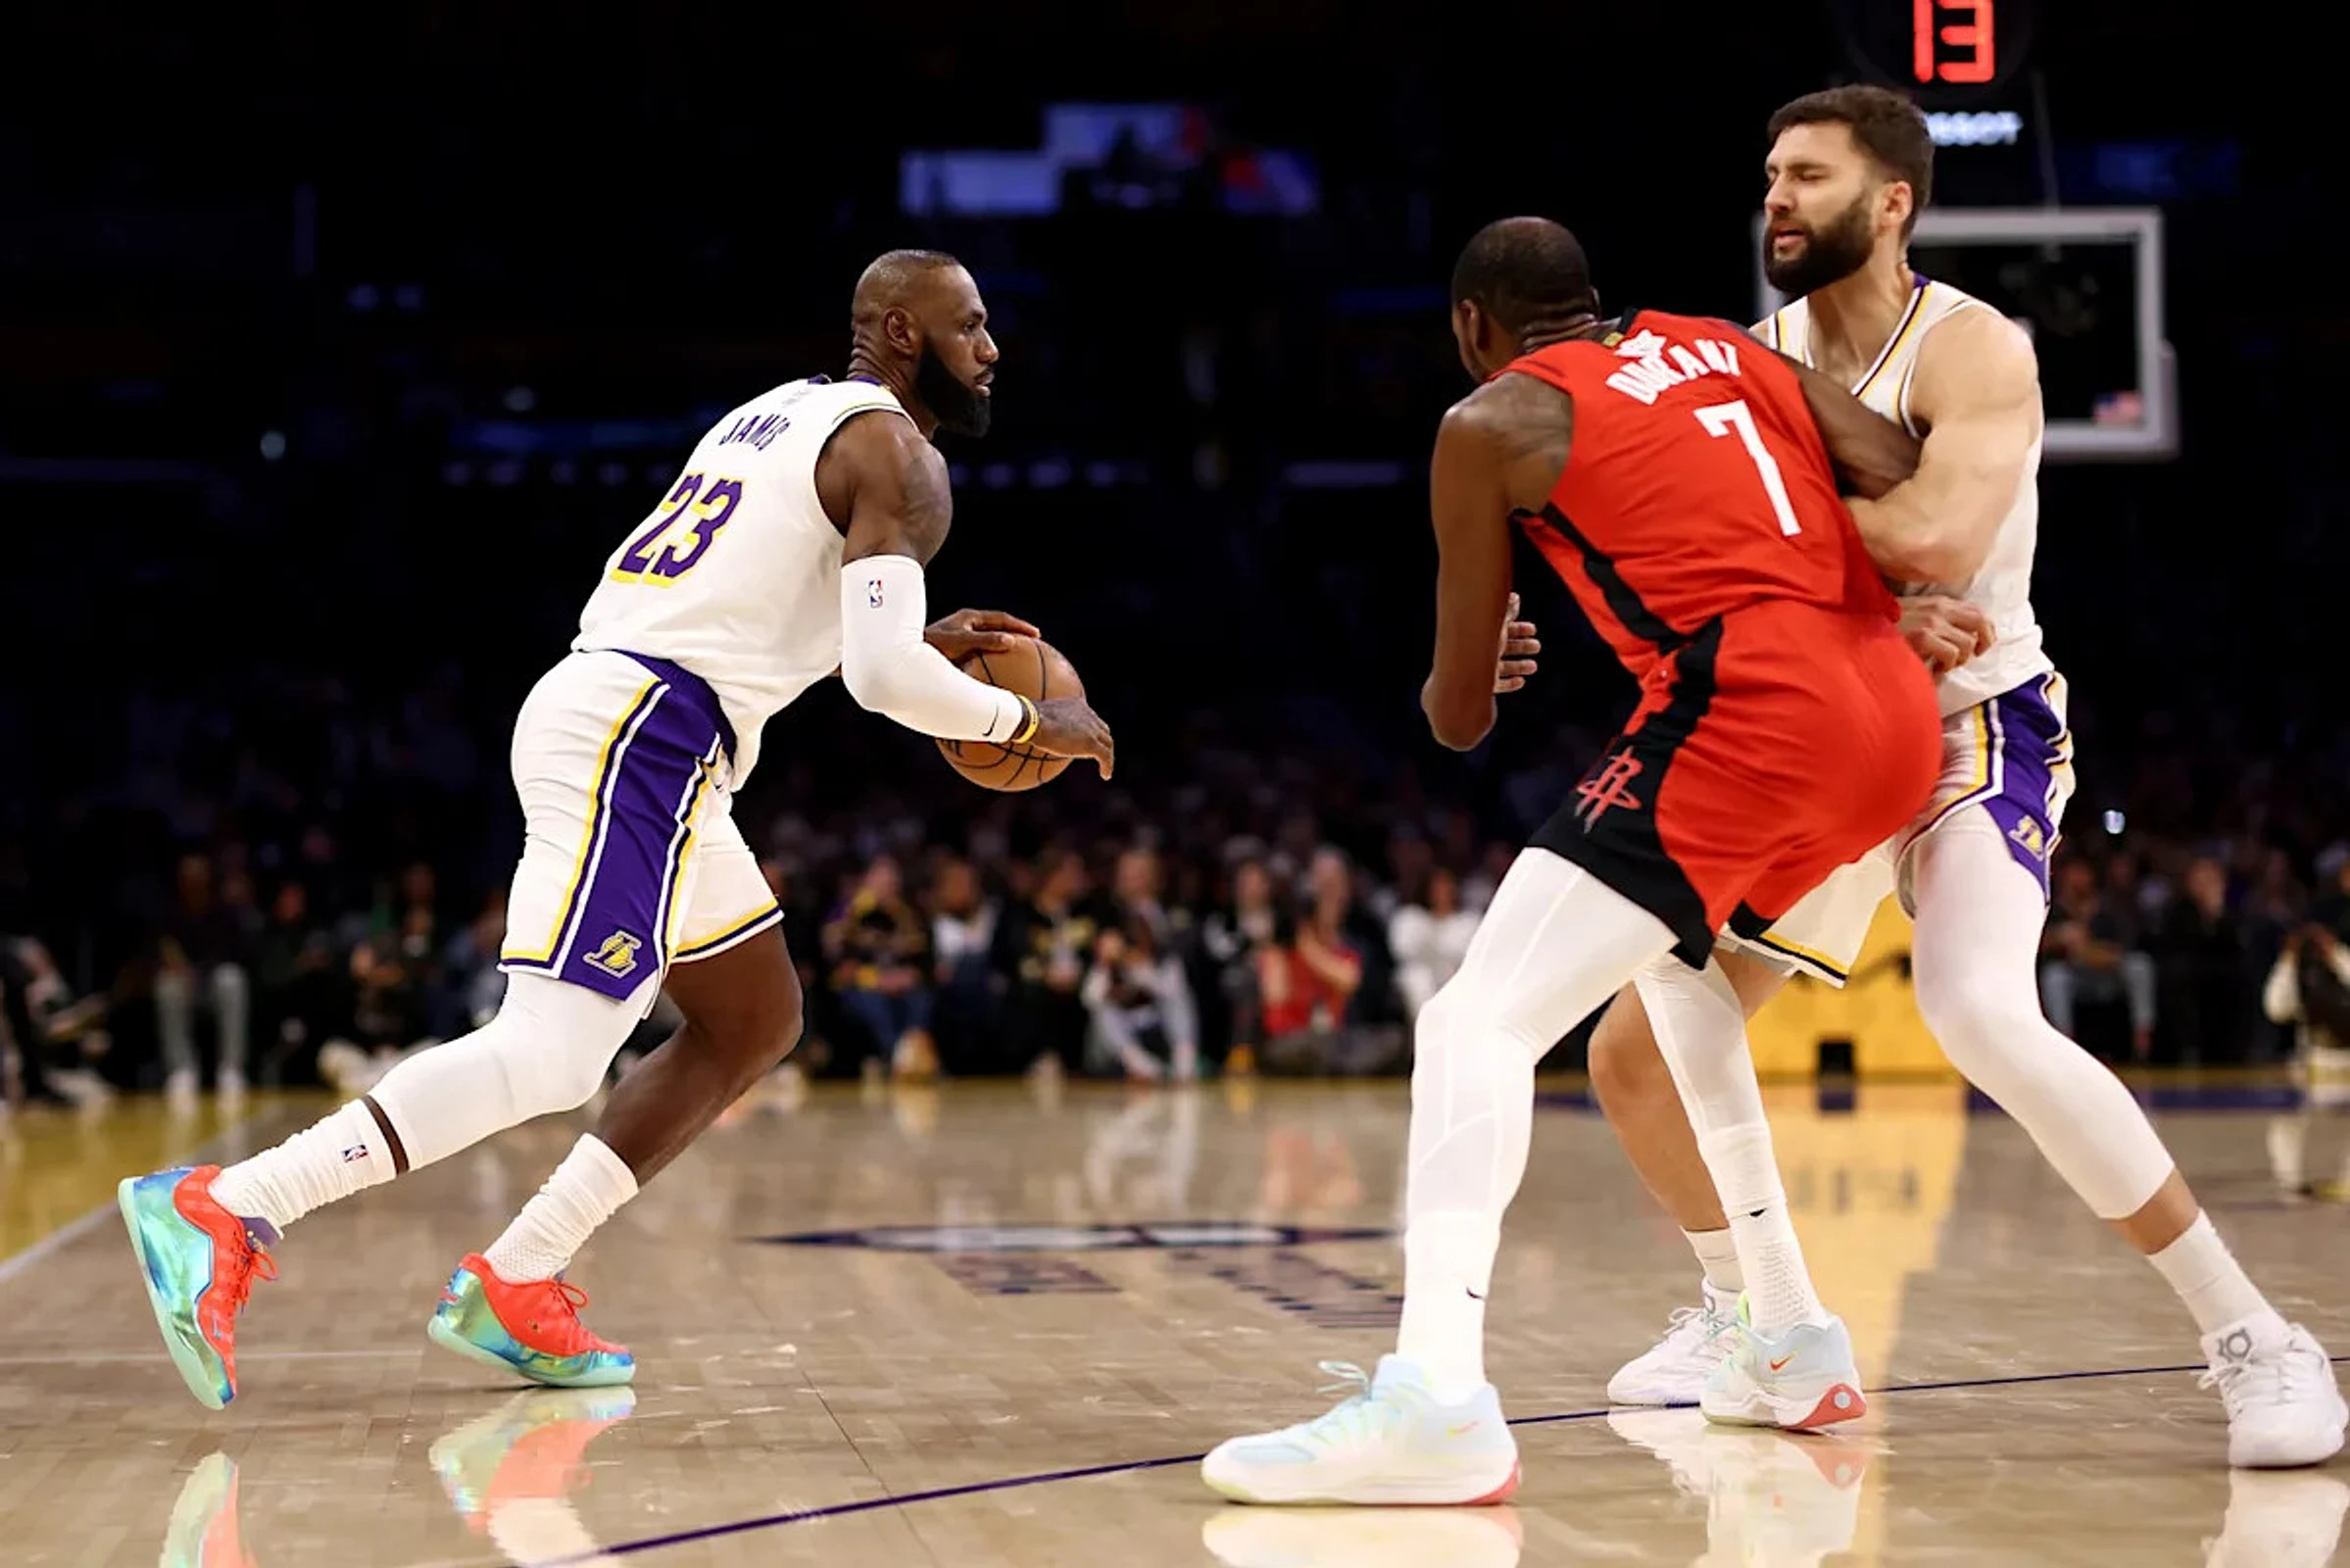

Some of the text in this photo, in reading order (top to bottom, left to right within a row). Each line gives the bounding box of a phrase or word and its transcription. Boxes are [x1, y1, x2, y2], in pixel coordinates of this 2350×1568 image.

[1913, 0, 1995, 83] 13
[1692, 399, 1802, 537] 7
[610, 469, 746, 588] 23
